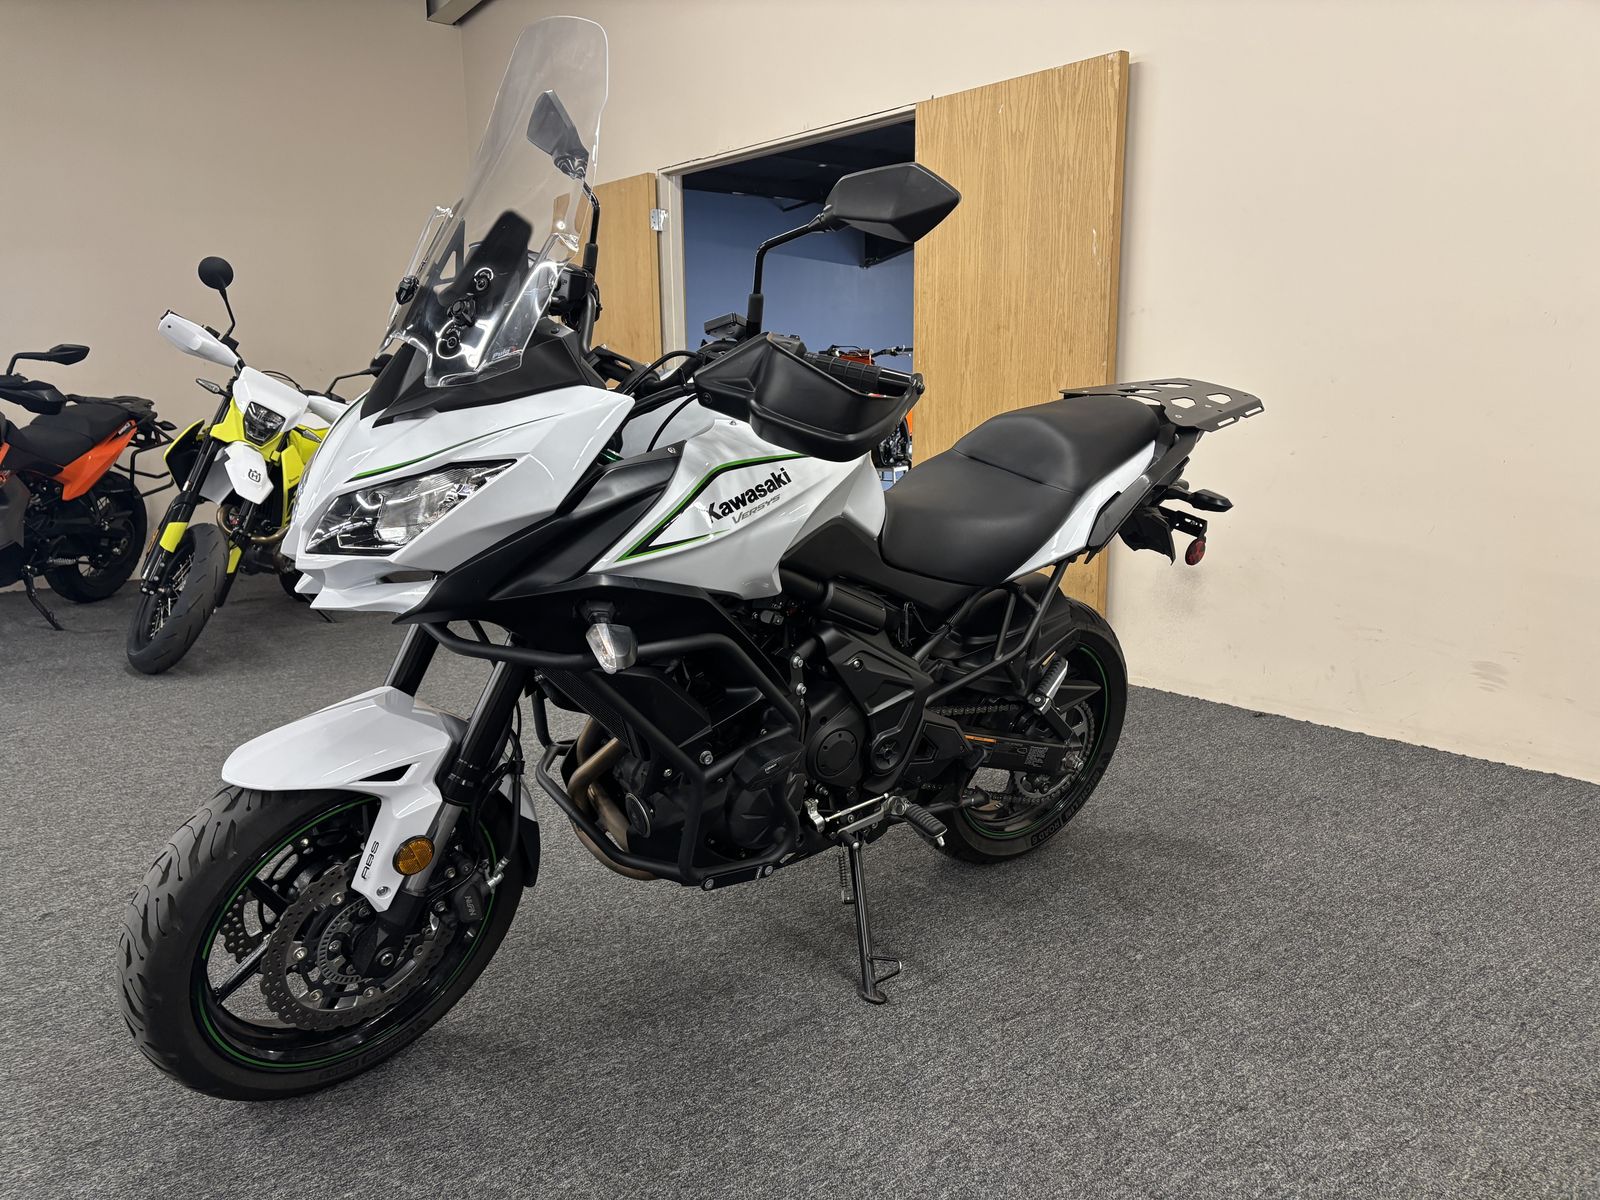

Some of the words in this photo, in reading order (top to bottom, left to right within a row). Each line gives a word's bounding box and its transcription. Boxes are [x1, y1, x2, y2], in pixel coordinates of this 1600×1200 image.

[706, 467, 792, 523] Kawasaki
[1038, 818, 1060, 840] ROAD
[361, 840, 380, 880] ABS
